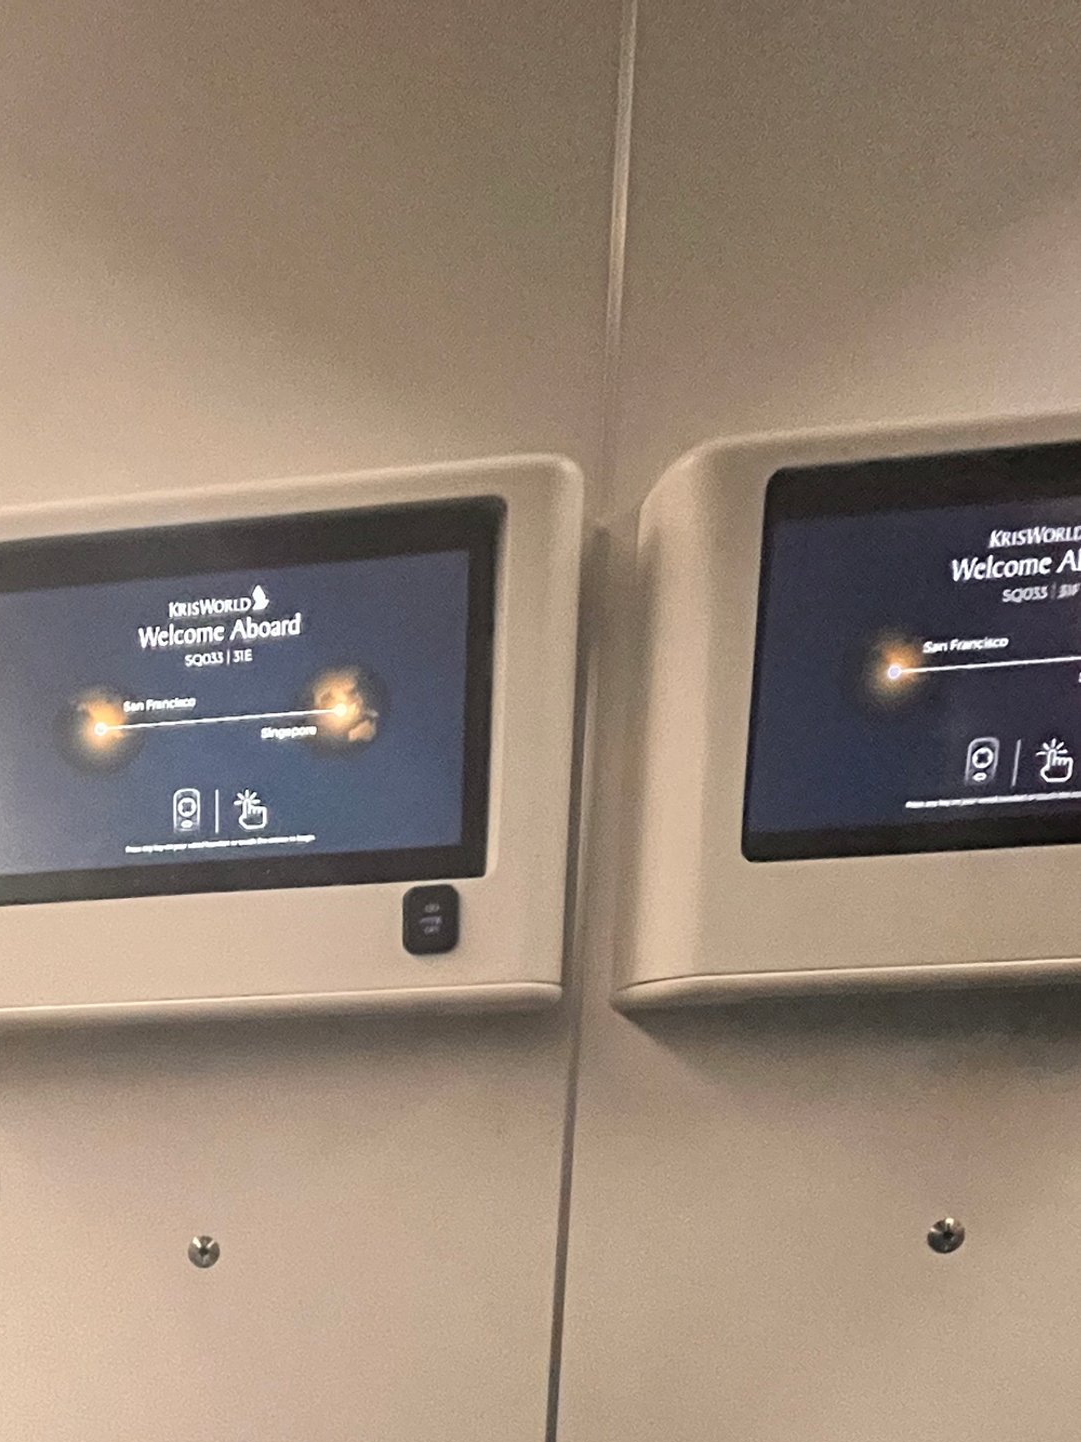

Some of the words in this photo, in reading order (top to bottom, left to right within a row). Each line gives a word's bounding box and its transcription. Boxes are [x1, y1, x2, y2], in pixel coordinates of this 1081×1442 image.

[952, 555, 1052, 582] Welcome
[168, 597, 252, 618] KRISWORLD
[138, 623, 225, 648] Welcome
[229, 612, 302, 641] Aboard
[922, 641, 947, 653] San
[949, 637, 1009, 651] Francisco
[184, 651, 224, 667] SQ033
[233, 649, 253, 663] 31E
[123, 700, 145, 712] San
[145, 697, 197, 711] Francisco
[260, 725, 317, 739] Singapore
